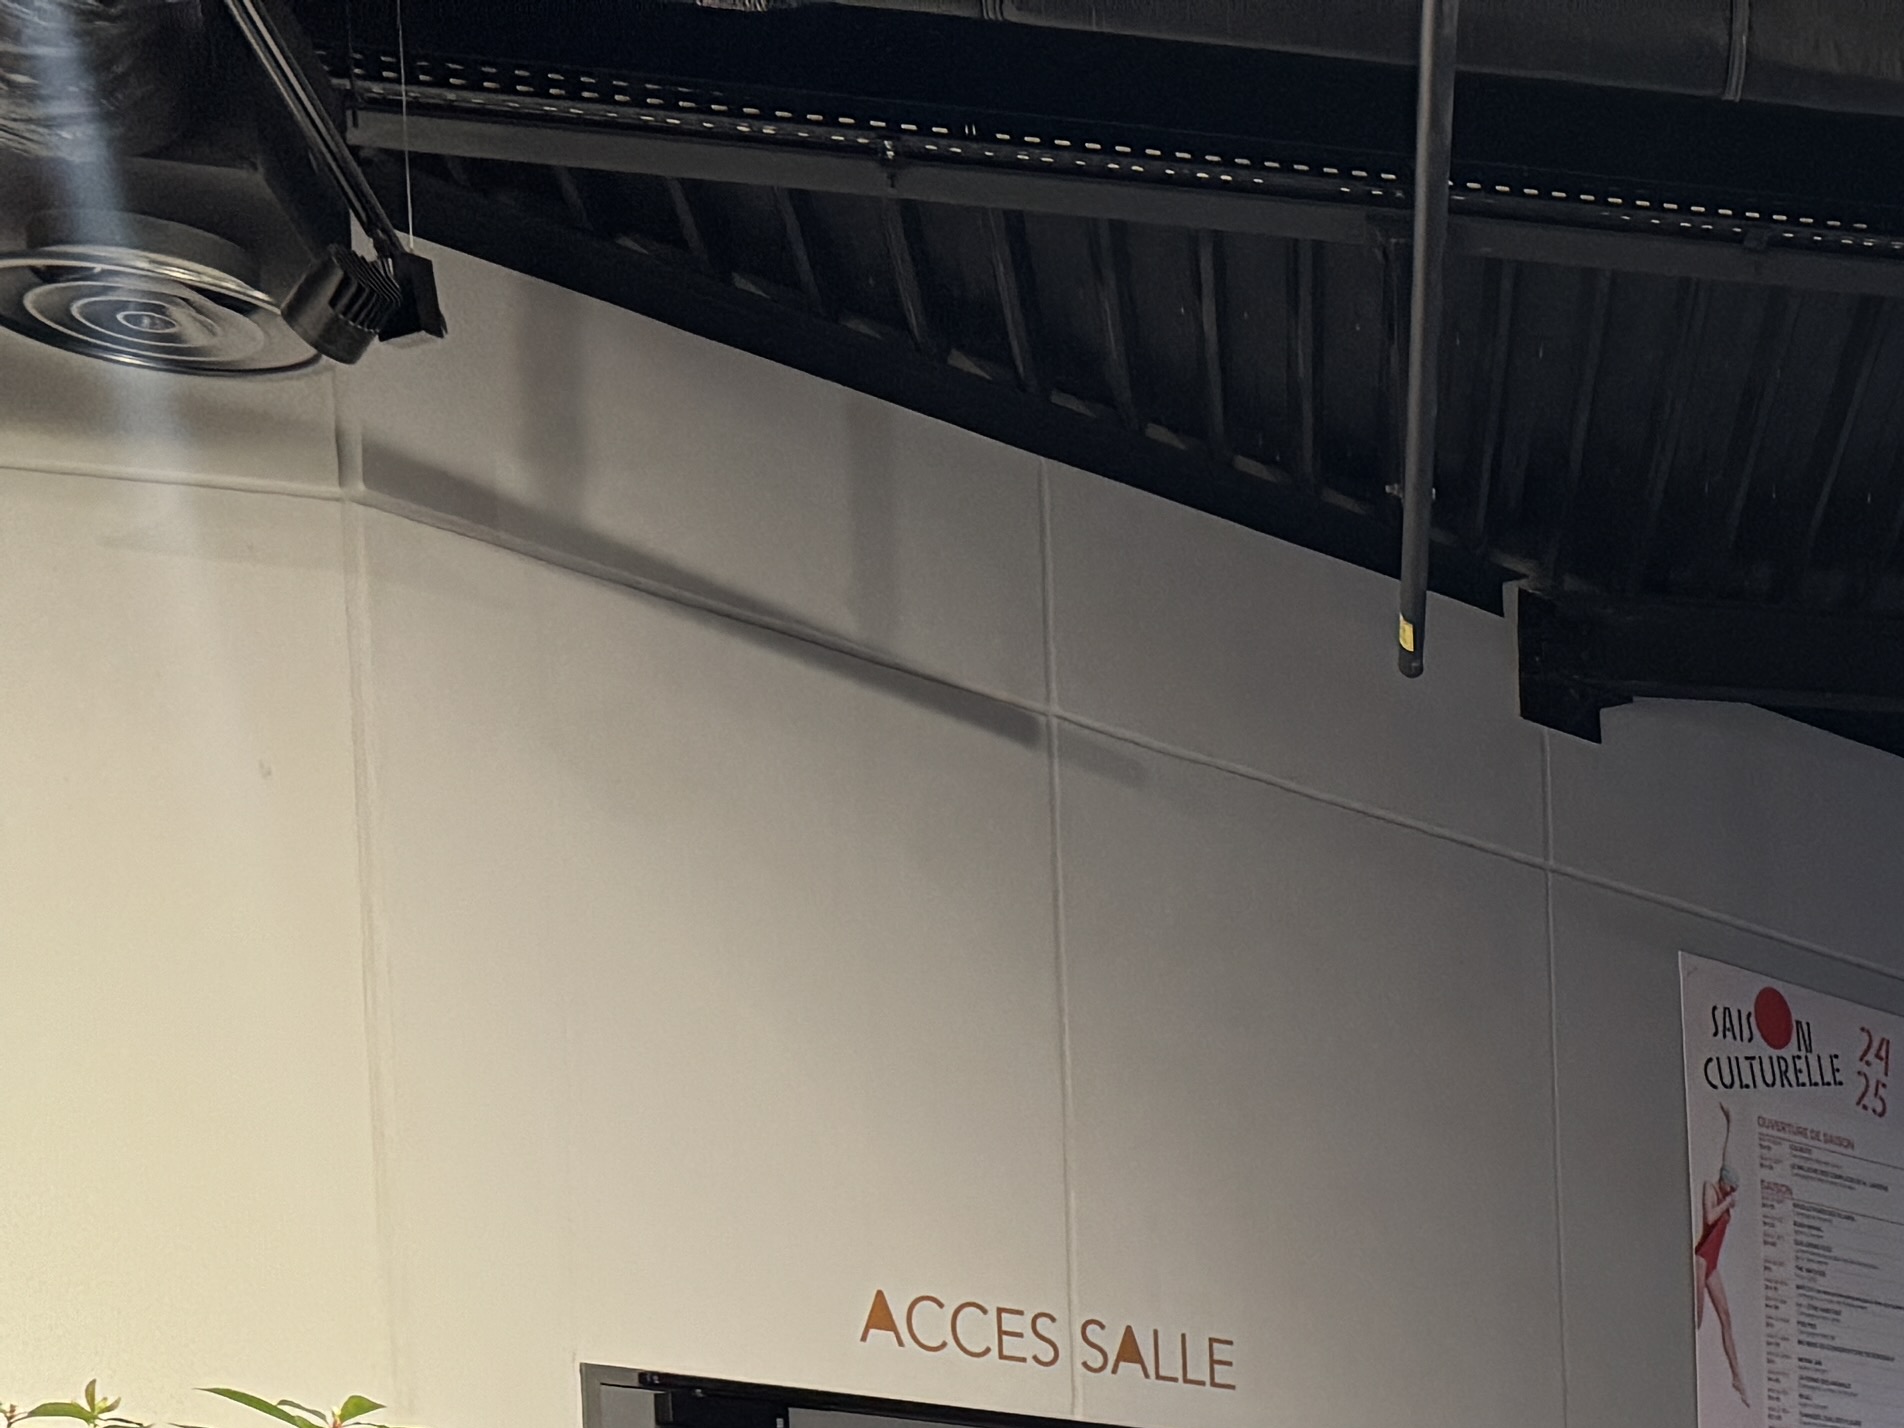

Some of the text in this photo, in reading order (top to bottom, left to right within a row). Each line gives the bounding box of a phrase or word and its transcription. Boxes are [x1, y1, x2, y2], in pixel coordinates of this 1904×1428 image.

[1711, 986, 1813, 1054] SAISON
[1703, 1053, 1844, 1090] CULTURELLE
[1859, 1026, 1891, 1078] 24
[1856, 1070, 1888, 1118] 25
[859, 1289, 1237, 1391] ACCES SALLE
